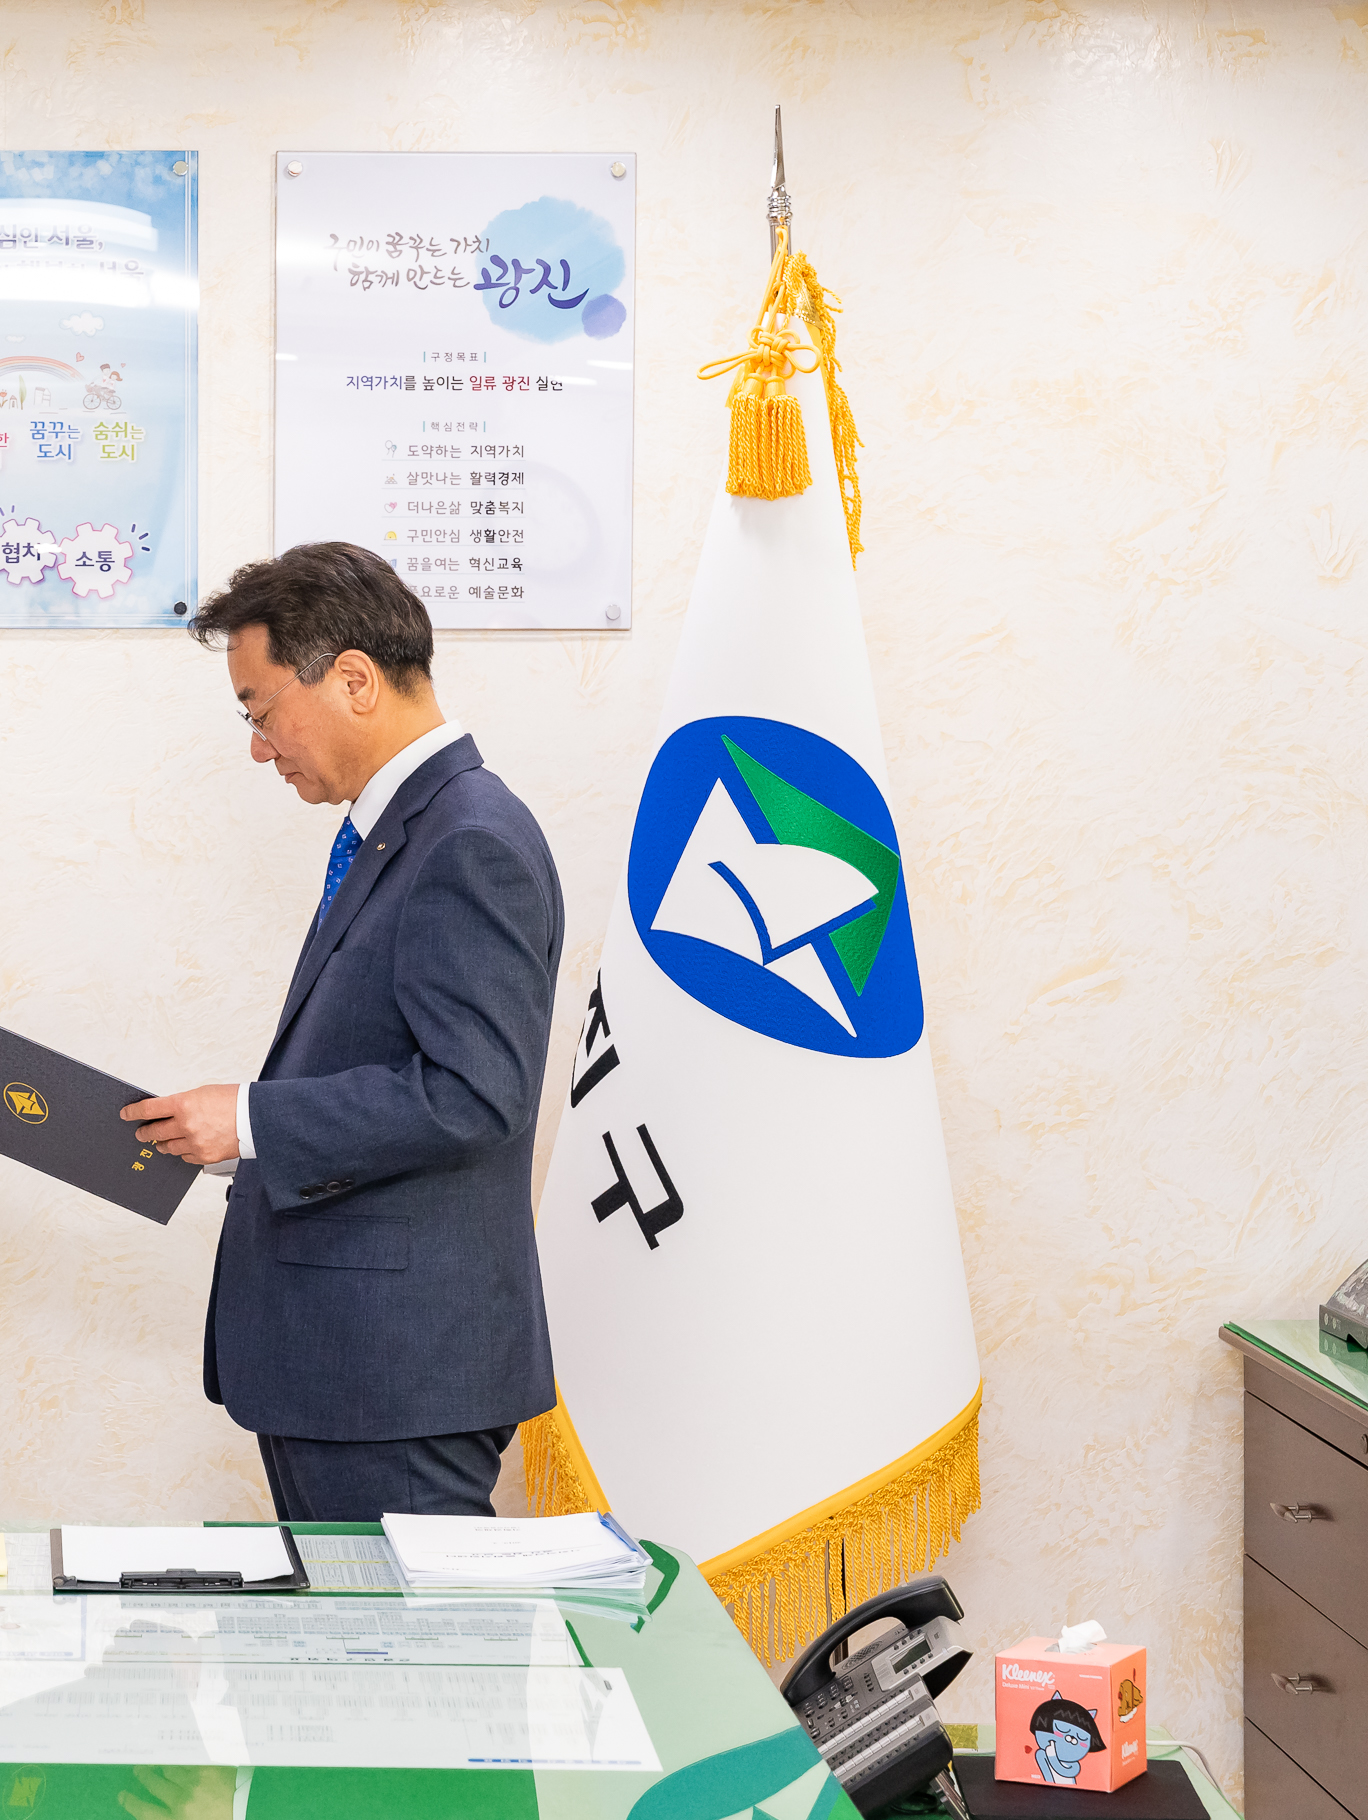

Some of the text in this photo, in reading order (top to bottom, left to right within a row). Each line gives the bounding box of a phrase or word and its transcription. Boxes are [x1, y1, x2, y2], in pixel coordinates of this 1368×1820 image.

[48, 224, 104, 251] 서울,
[385, 232, 448, 263] 꿈꾸는
[450, 235, 490, 254] 가치
[348, 254, 590, 309] 함께 만드는 광진
[346, 376, 417, 391] 지역가치를
[422, 376, 464, 391] 높이는
[469, 376, 495, 391] 일류
[502, 376, 530, 391] 광진
[29, 421, 81, 441] 꿈꾸는
[93, 421, 145, 441] 숨쉬는
[37, 444, 72, 461] 도시
[100, 444, 136, 461] 도시
[407, 445, 524, 459] 도약하는 지역가치
[407, 471, 524, 486] 살맛나는 활력경제
[407, 501, 524, 515] 더나은삶 맞춤복지
[407, 529, 524, 543] 구민안심 생활안전
[1, 542, 42, 563] 협치
[75, 550, 116, 572] 소통
[407, 557, 523, 572] 꿈을여는 혁신교육
[468, 586, 524, 600] 예술문화
[1002, 1663, 1055, 1687] Kleenex
